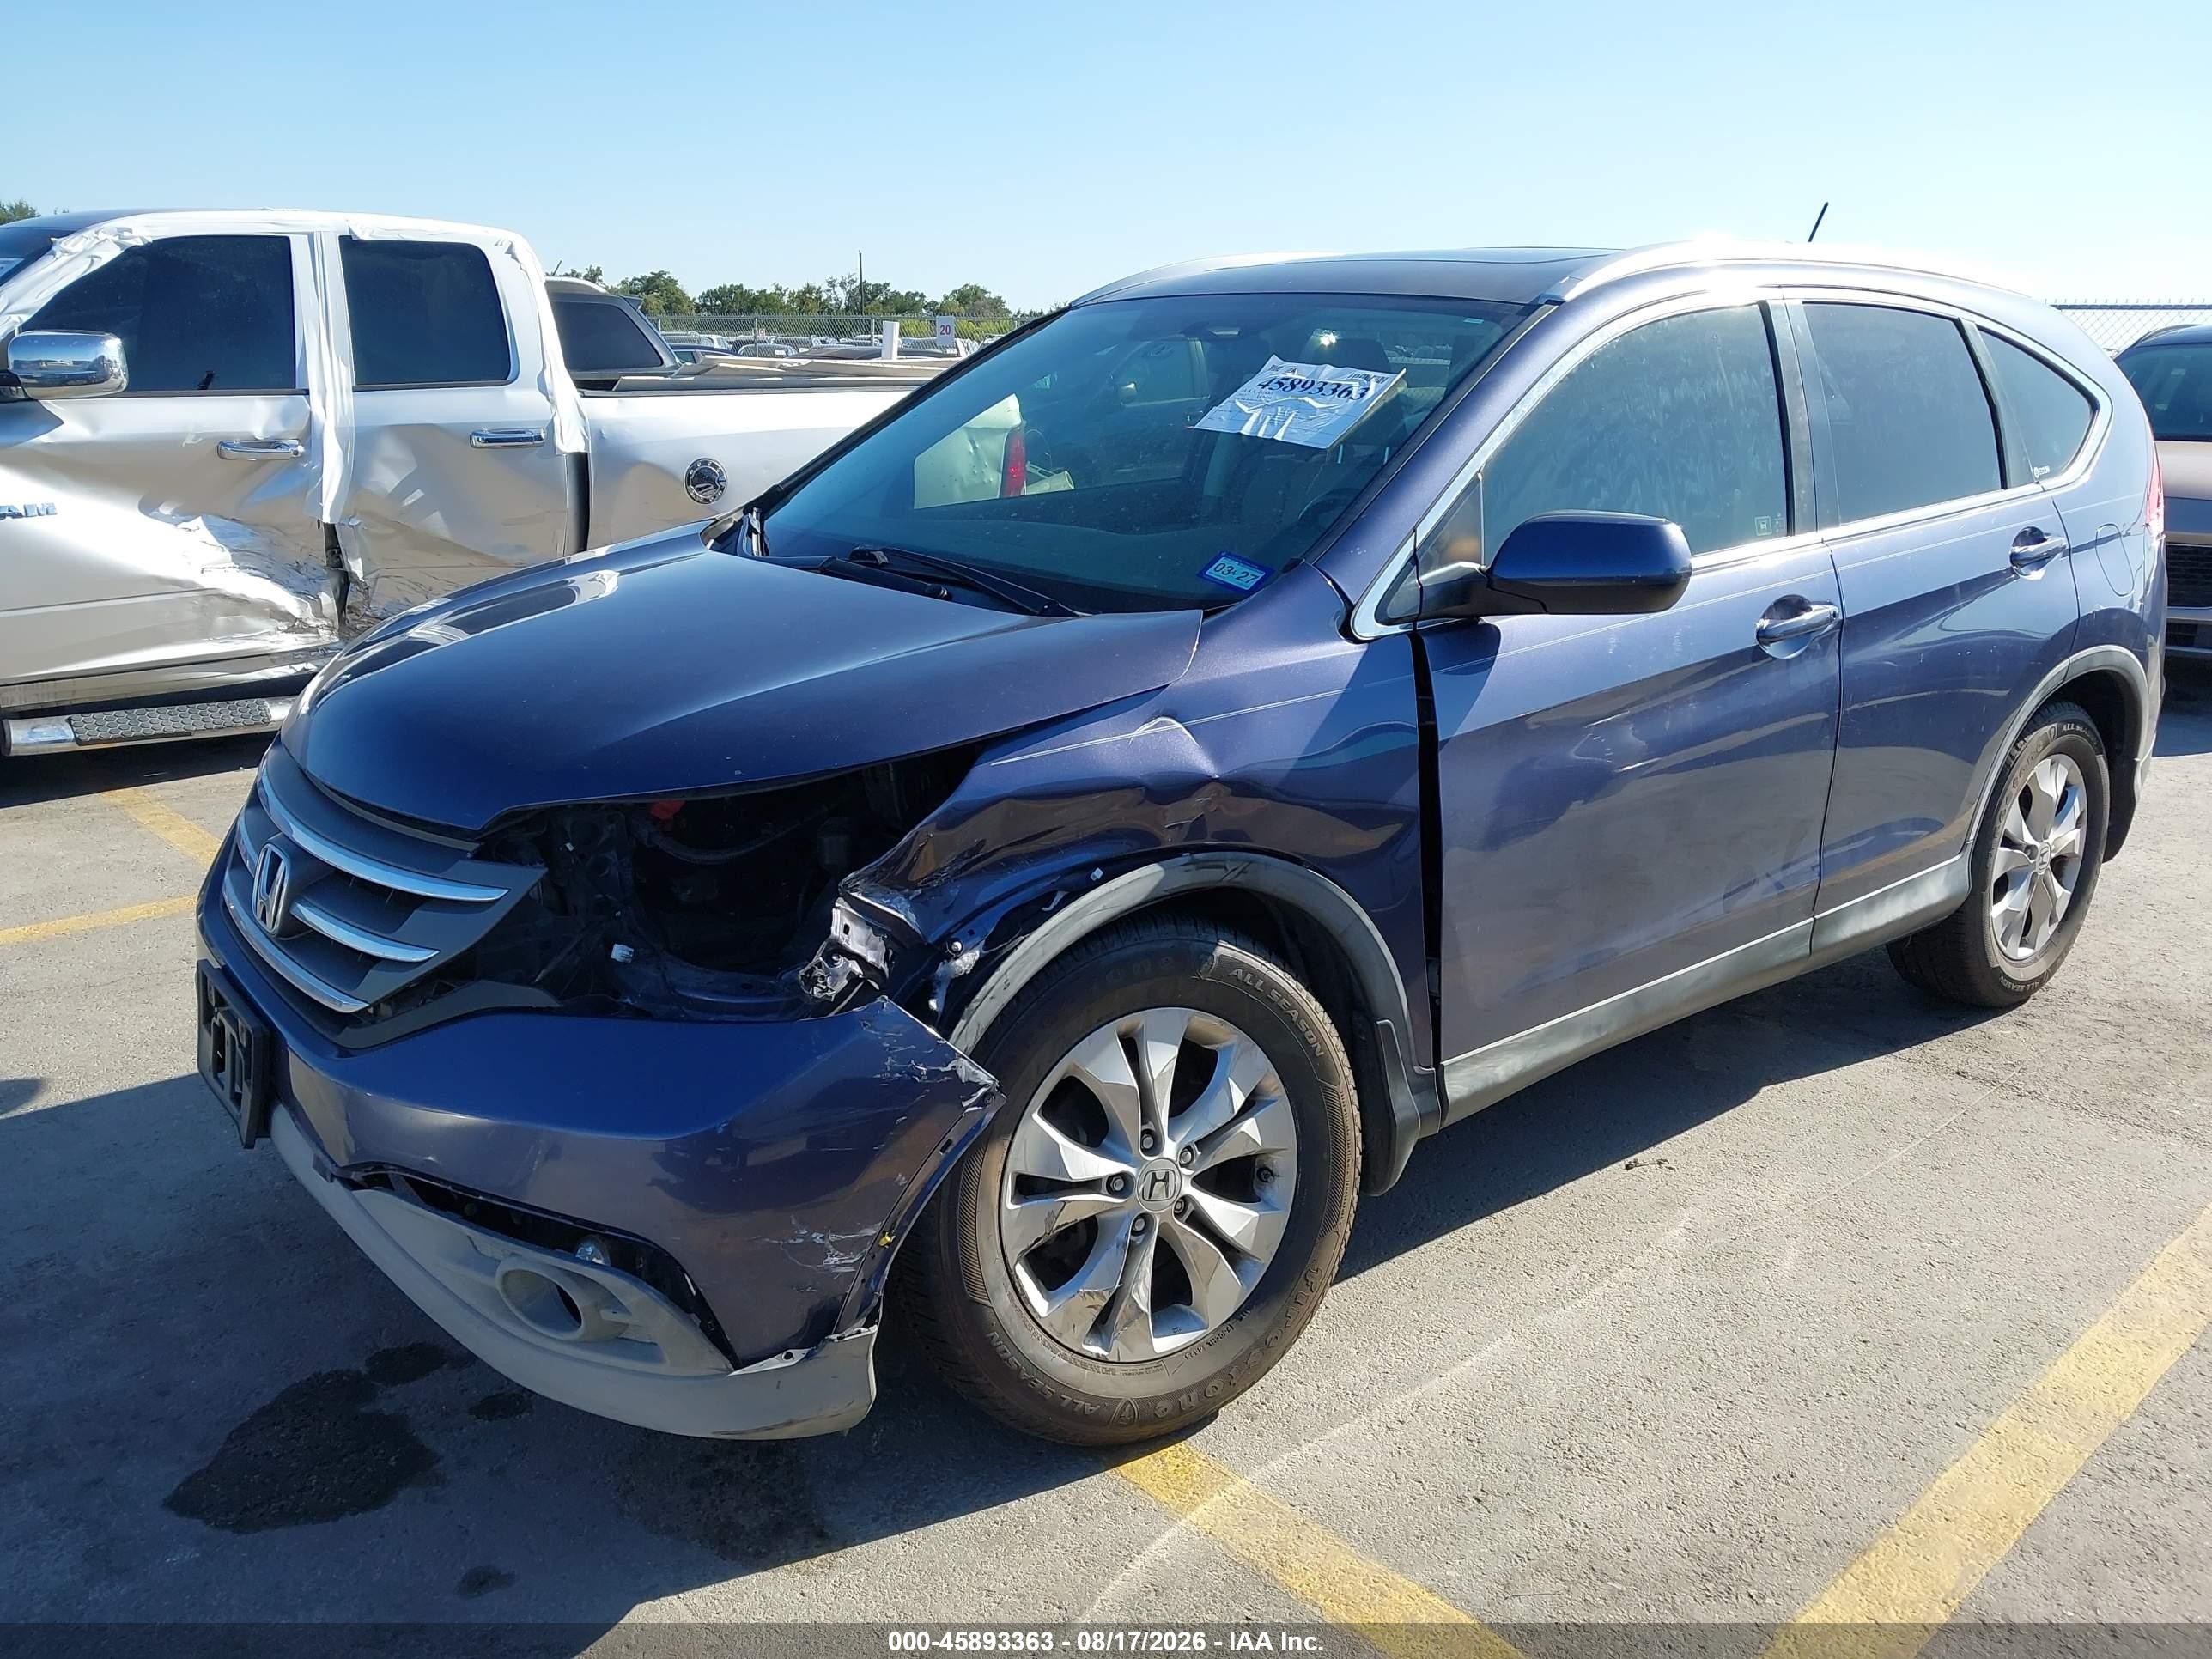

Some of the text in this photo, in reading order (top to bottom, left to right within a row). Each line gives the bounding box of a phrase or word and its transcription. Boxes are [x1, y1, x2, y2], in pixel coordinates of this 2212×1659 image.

[939, 325, 951, 336] 20
[1258, 376, 1370, 400] 45893363
[1213, 562, 1260, 585] 03 27
[1229, 968, 1324, 1058] ALL SEASON
[988, 1330, 1056, 1398] SEASON
[1060, 1393, 1101, 1416] ALL
